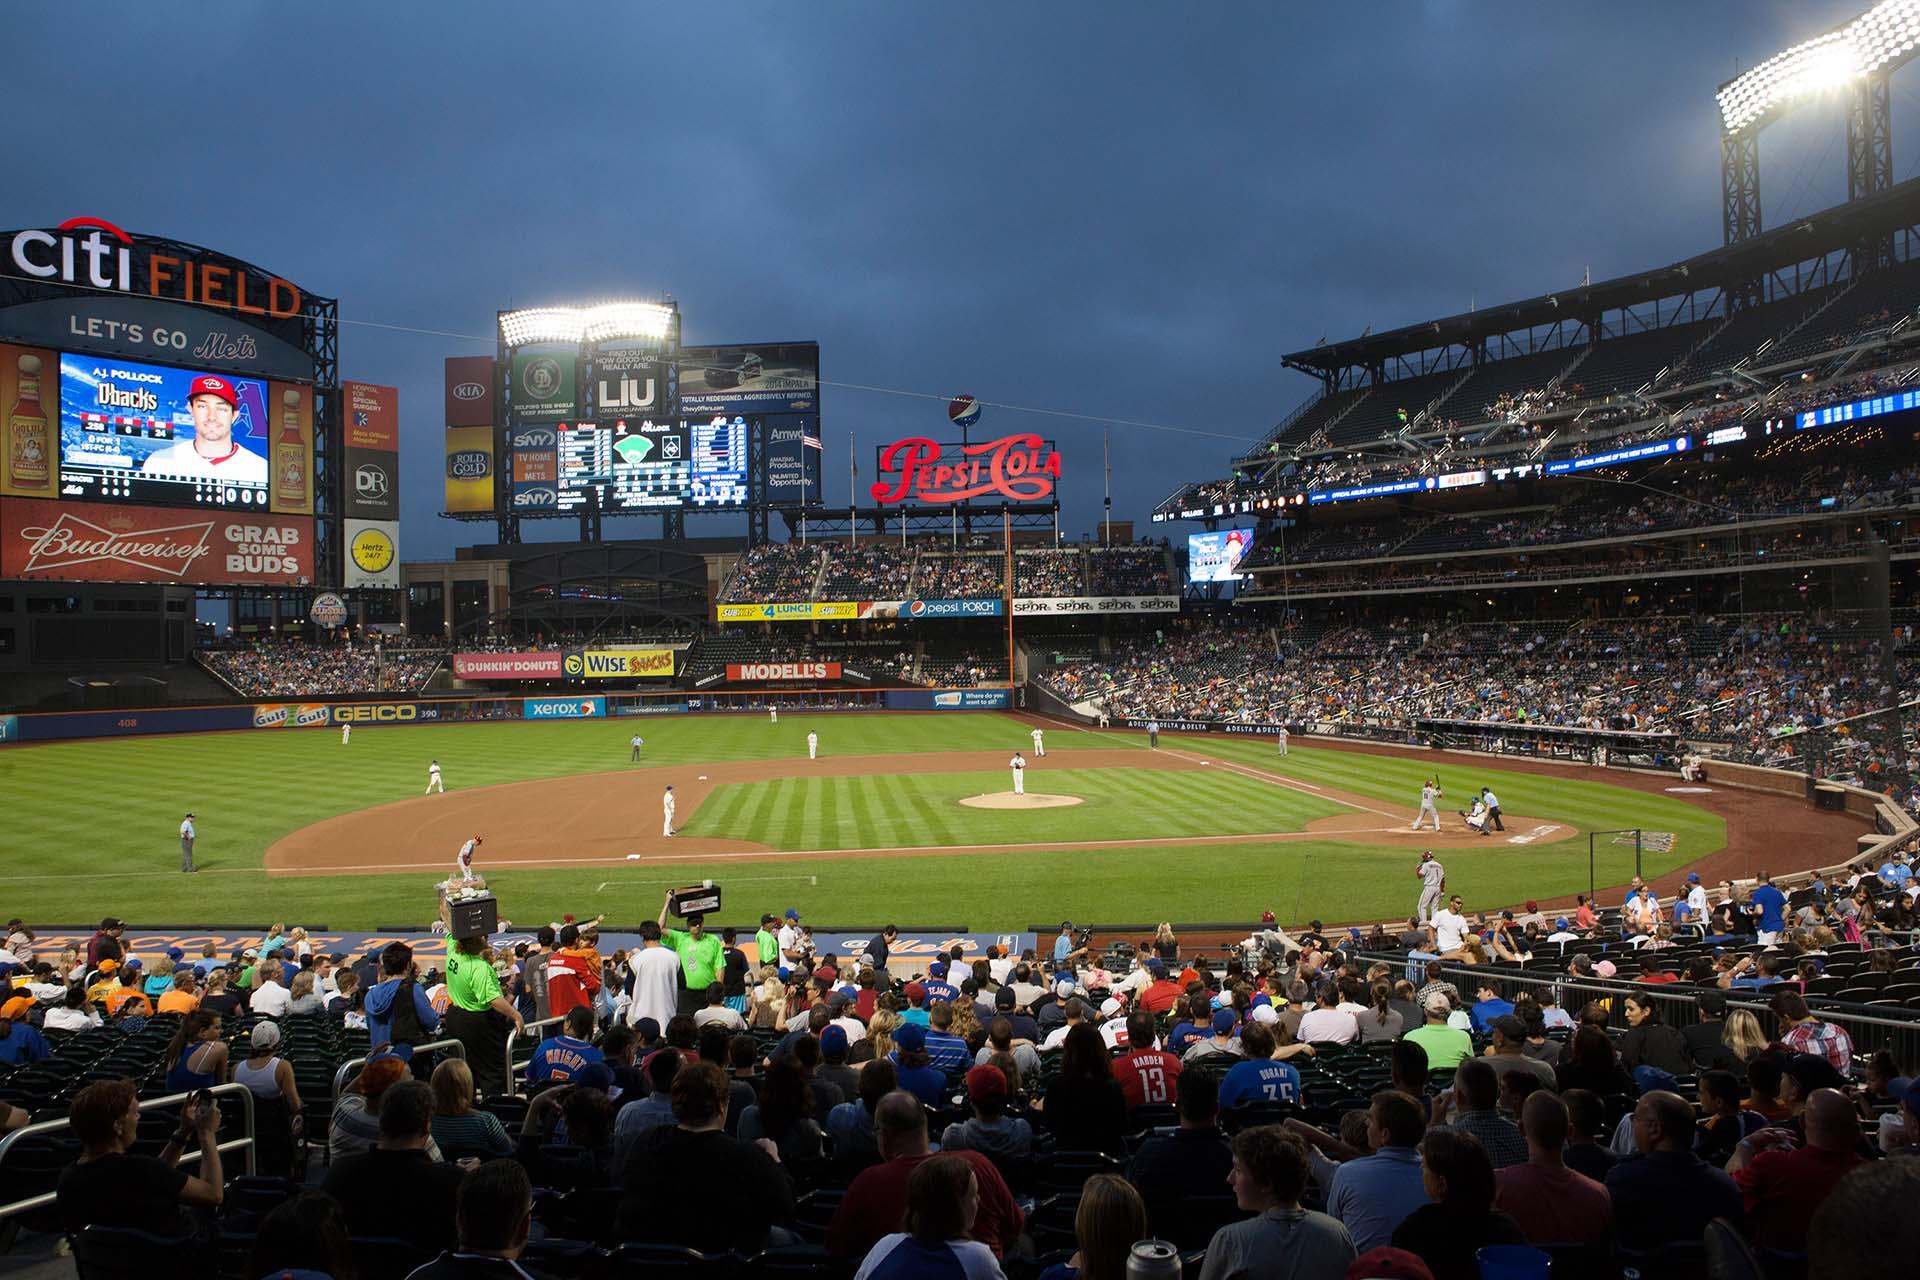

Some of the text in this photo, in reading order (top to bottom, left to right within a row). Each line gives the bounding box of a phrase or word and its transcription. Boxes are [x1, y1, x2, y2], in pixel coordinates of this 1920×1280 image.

[11, 230, 300, 319] citi FIELD
[70, 315, 257, 360] LET'S GO Mets
[111, 370, 163, 385] POLLOCK
[765, 379, 809, 389] 2014 IMPALA
[458, 386, 480, 397] KIA
[599, 374, 655, 407] LIU
[353, 397, 377, 406] SPECIAL
[681, 391, 813, 403] TOTALLY REDESIGNED. AGGRESSIVELY REFINED.
[352, 403, 382, 413] SURGERY
[513, 434, 549, 448] SNY
[456, 453, 485, 465] ROLD
[519, 453, 552, 462] TV HOME
[453, 461, 486, 476] GOLD
[525, 472, 546, 481] METS
[514, 494, 549, 506] SNY
[1181, 509, 1204, 518] POLLOCK
[225, 525, 299, 545] GRAB
[21, 527, 208, 559] Budweiser
[238, 543, 287, 555] SOME
[361, 543, 383, 552] Hertz
[227, 555, 299, 574] BUDS
[721, 606, 756, 617] SUBWAY
[777, 604, 813, 613] LUNCH
[819, 604, 855, 616] SUBWAY
[927, 602, 994, 614] pepsi PORCH
[467, 660, 559, 672] DUNKIN' DONUTS
[587, 652, 673, 674] WISE SNACKS
[741, 663, 827, 680] MODELL'S
[533, 702, 578, 715] xerox
[688, 699, 701, 708] 375
[256, 708, 329, 725] Gulf Gulf
[334, 705, 416, 722] GEICO
[421, 710, 437, 719] 390
[117, 719, 137, 728] 408
[1186, 723, 1207, 731] DELTA
[1231, 725, 1253, 733] DELTA
[545, 1049, 588, 1072] WRIGHT
[1132, 1054, 1164, 1068] HARDEN
[1258, 1068, 1288, 1081] DURANT
[1138, 1067, 1166, 1104] 13
